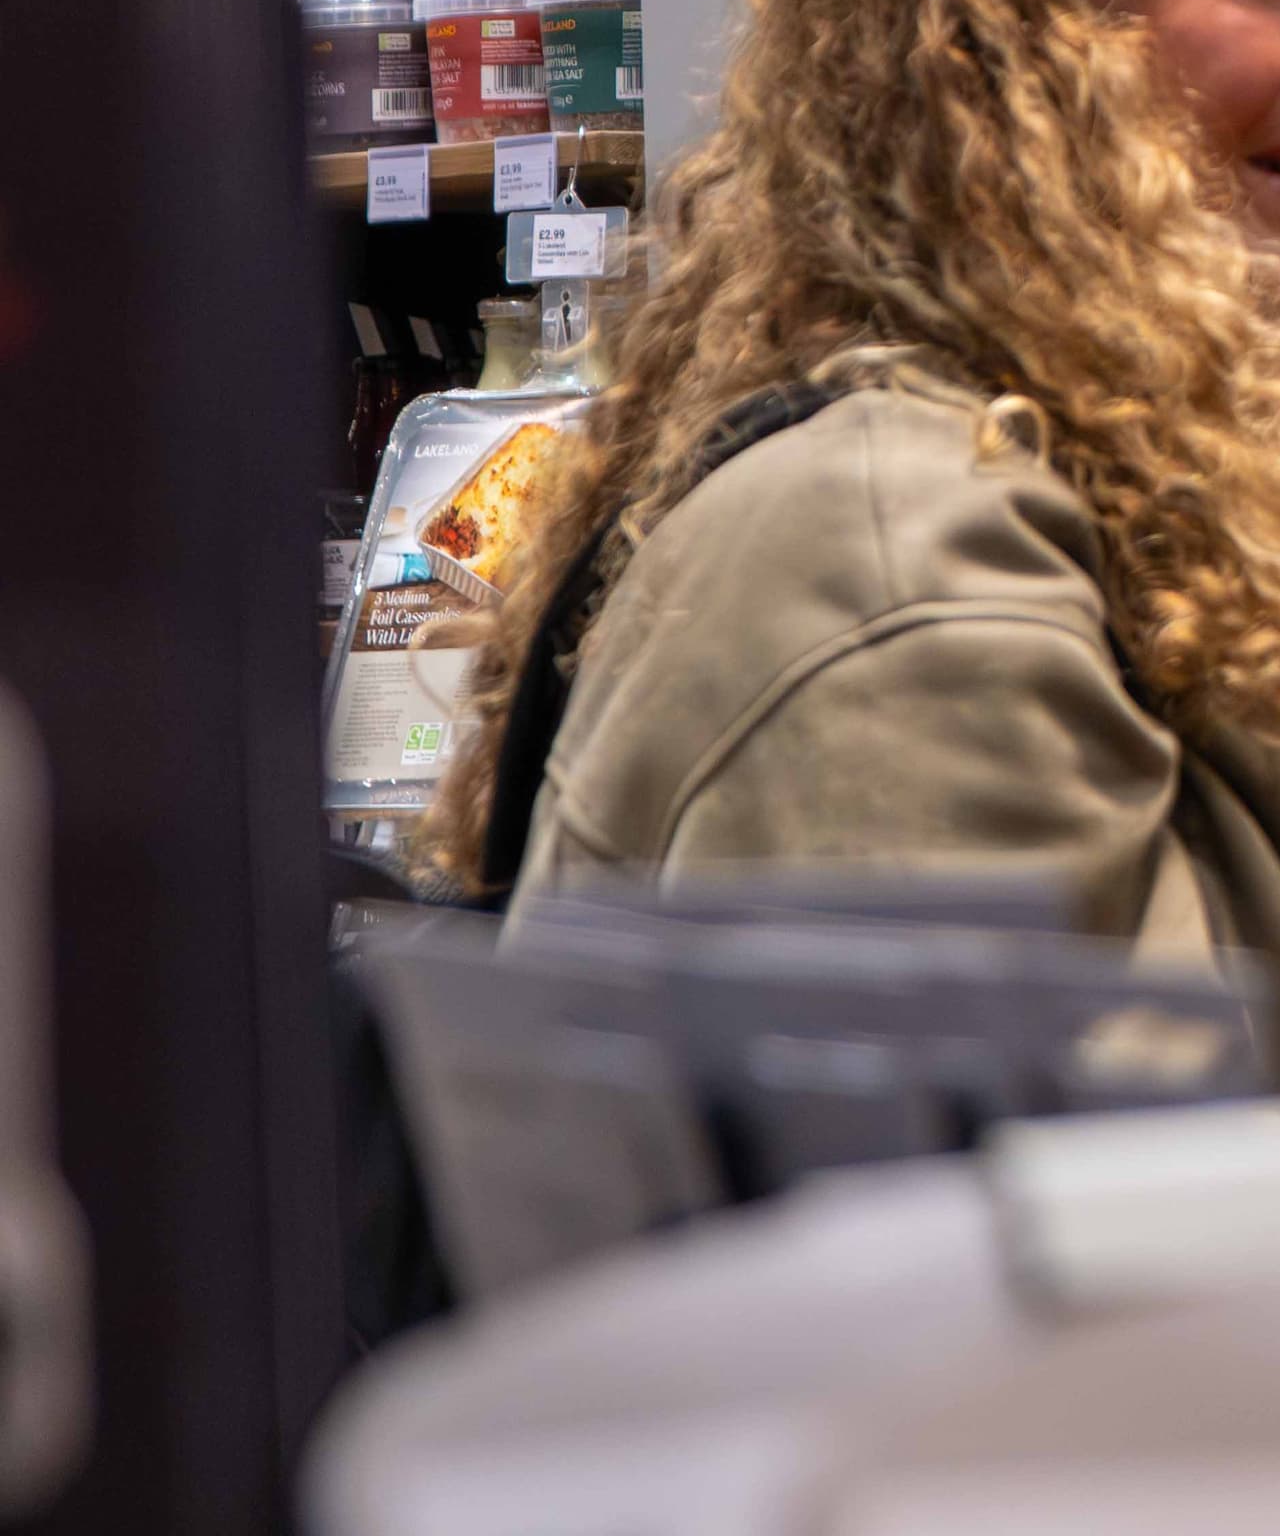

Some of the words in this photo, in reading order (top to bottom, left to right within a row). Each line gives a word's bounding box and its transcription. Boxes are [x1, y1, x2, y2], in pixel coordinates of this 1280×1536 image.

[539, 229, 565, 240] £2.99
[415, 442, 479, 459] LAKELAND
[374, 592, 383, 605] 5
[384, 591, 430, 606] Medium
[369, 608, 394, 625] Foil
[366, 628, 397, 646] With
